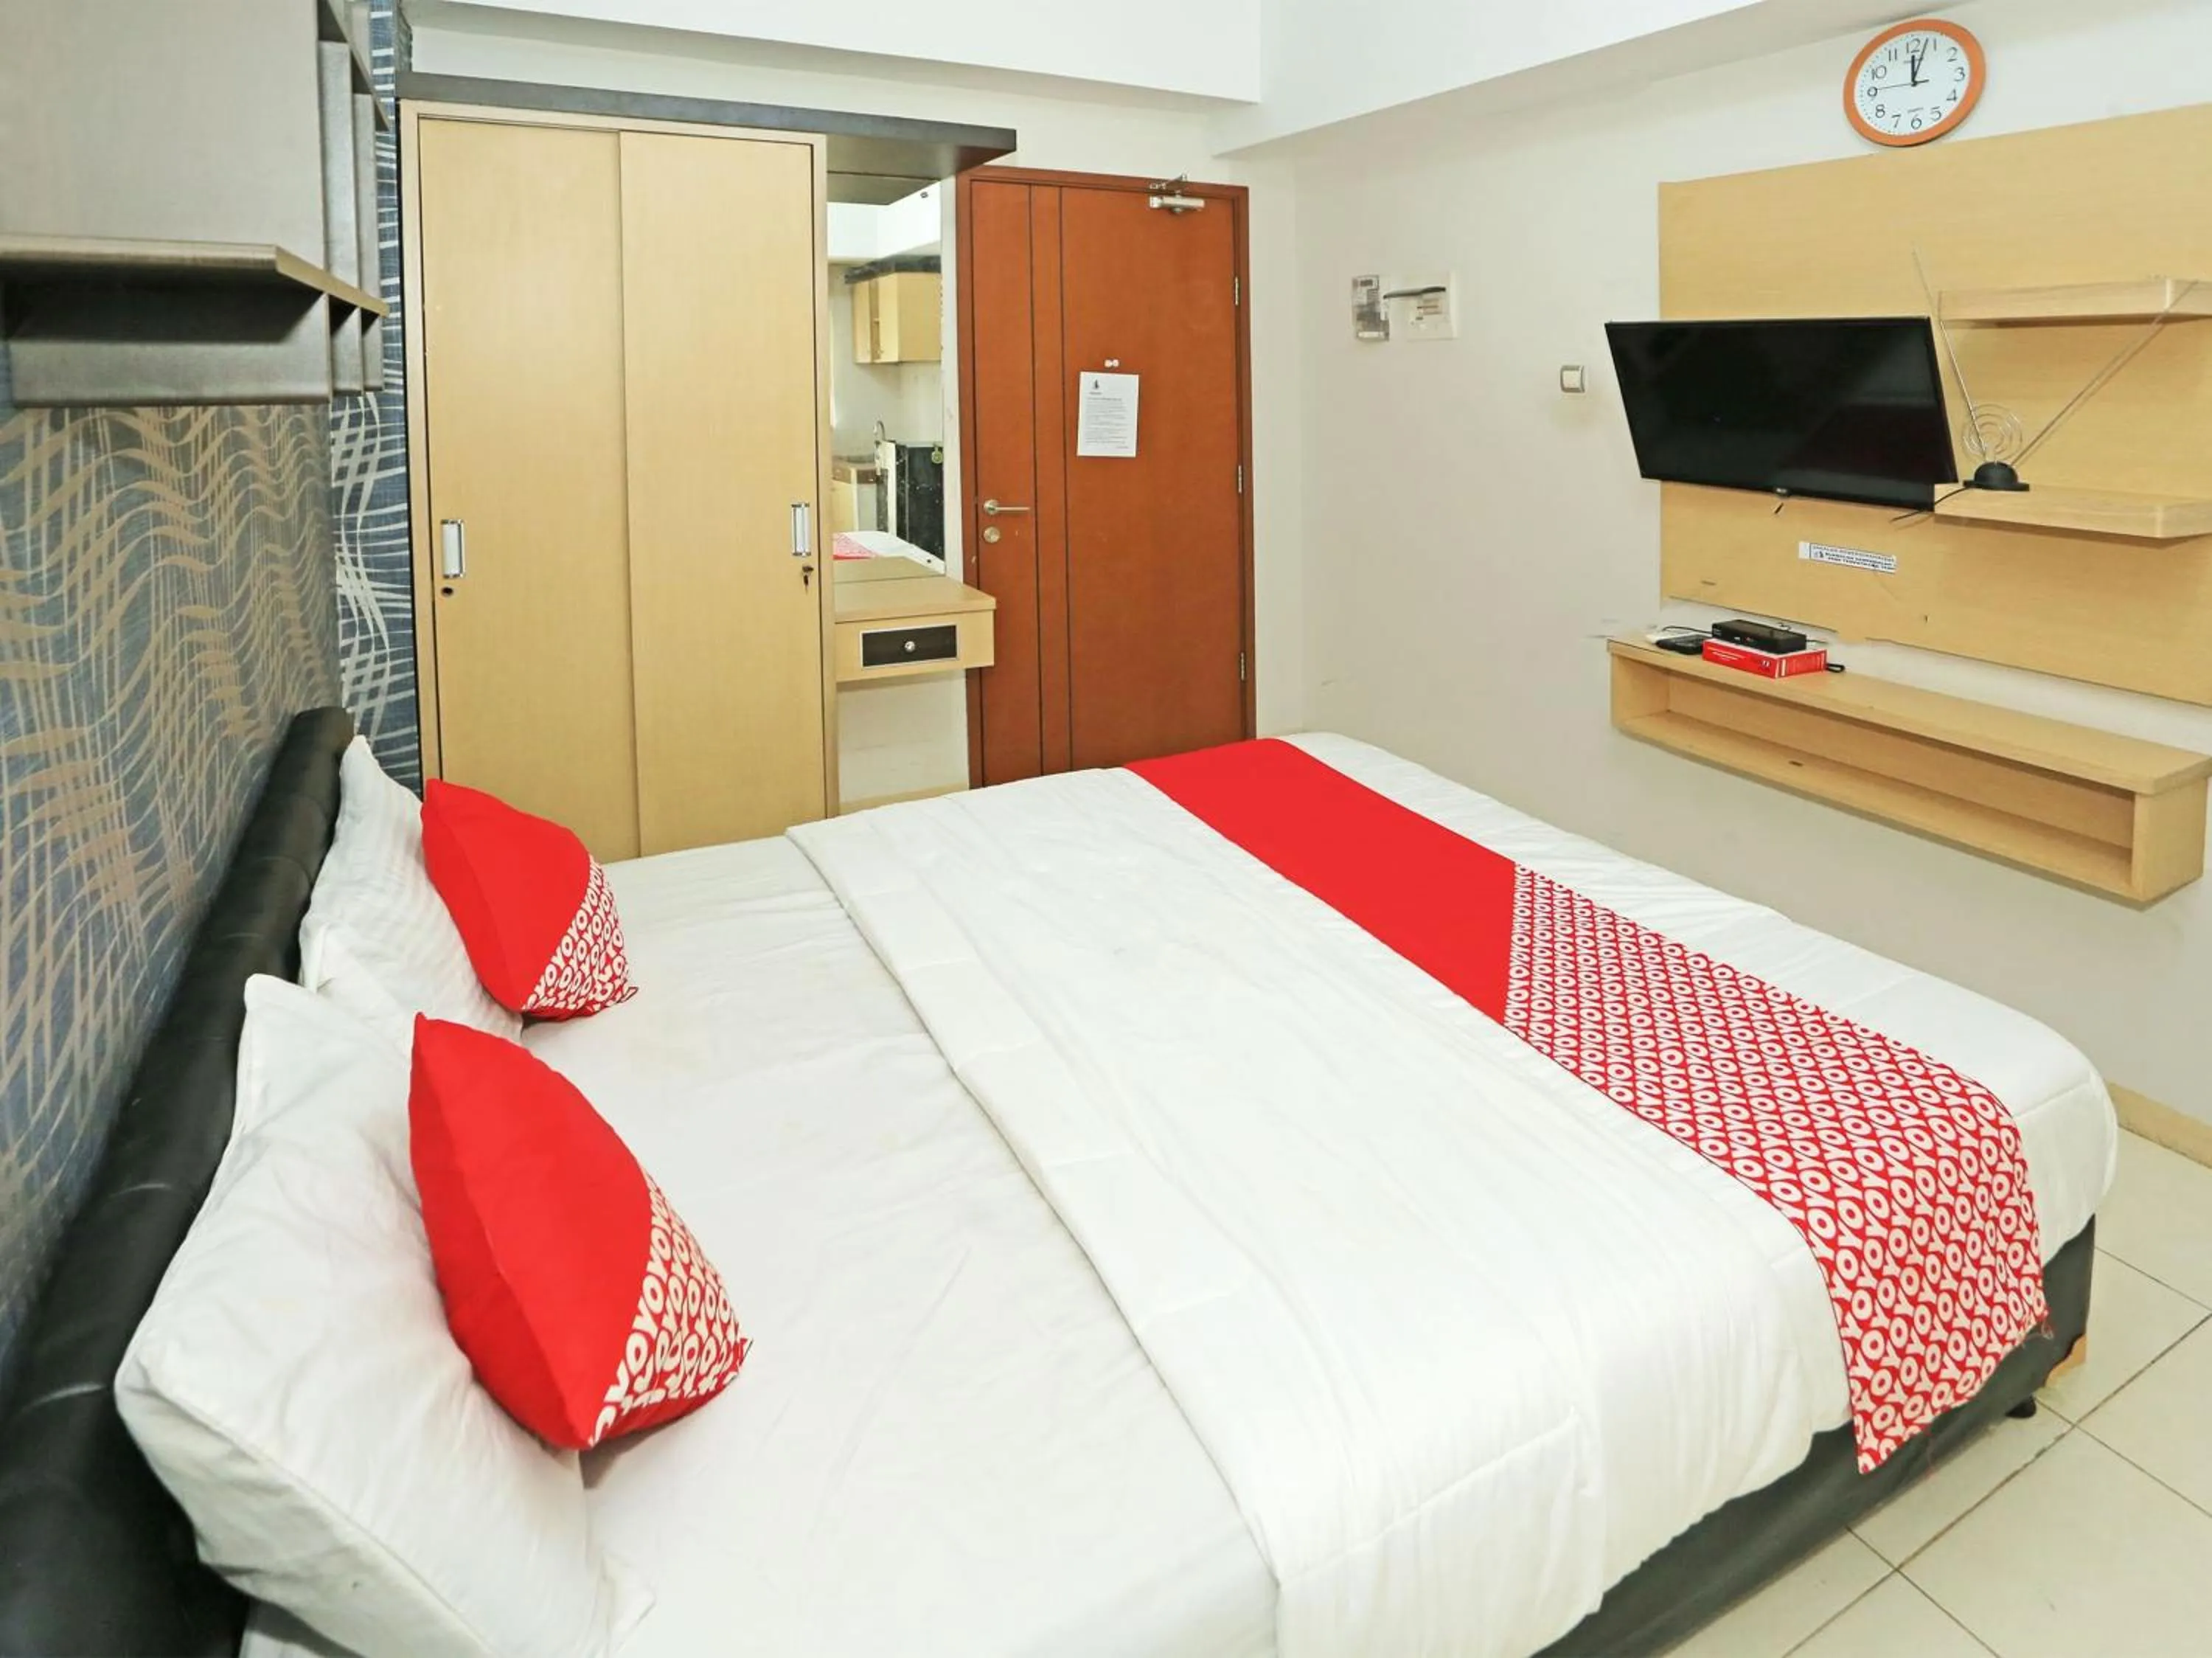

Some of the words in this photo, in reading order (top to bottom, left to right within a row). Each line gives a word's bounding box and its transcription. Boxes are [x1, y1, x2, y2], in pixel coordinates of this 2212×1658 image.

[1906, 38, 1921, 53] 12
[1933, 38, 1937, 51] 1
[1888, 48, 1898, 62] 11
[1947, 46, 1958, 62] 2
[1871, 65, 1887, 80] 10
[1954, 66, 1966, 81] 3
[1867, 86, 1878, 100] 9
[1946, 89, 1958, 101] 4
[1875, 104, 1885, 118] 8
[1930, 106, 1941, 120] 5
[1891, 114, 1902, 128] 7
[1910, 116, 1922, 130] 6
